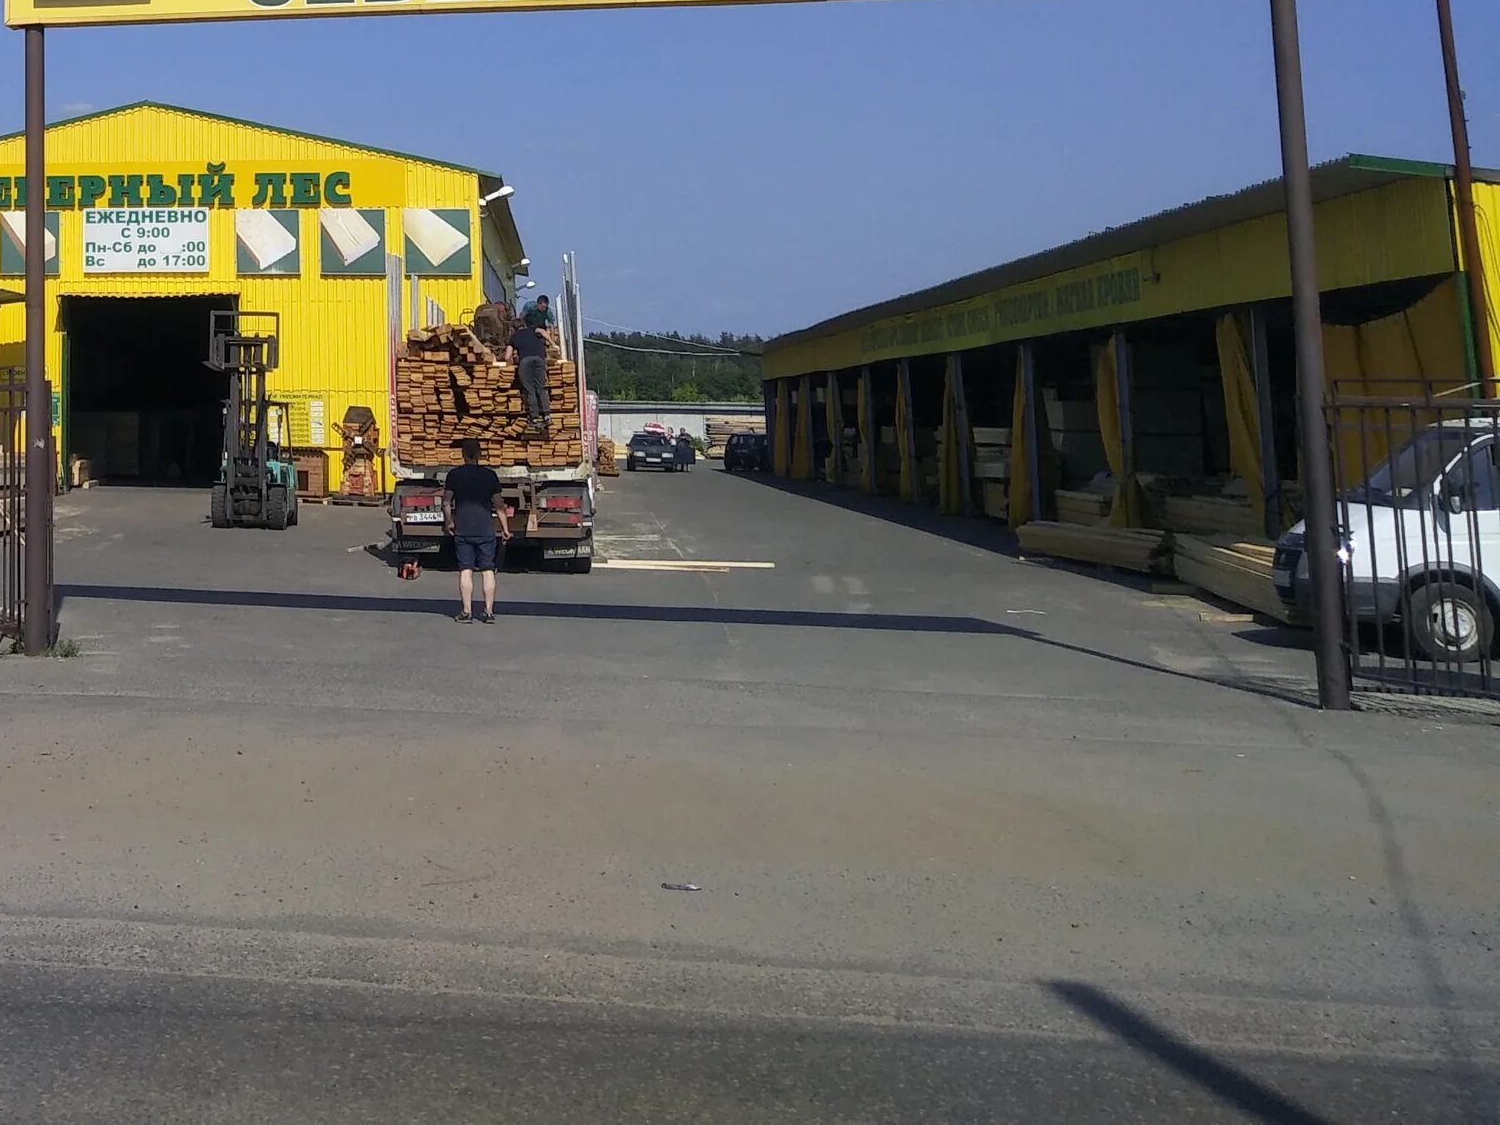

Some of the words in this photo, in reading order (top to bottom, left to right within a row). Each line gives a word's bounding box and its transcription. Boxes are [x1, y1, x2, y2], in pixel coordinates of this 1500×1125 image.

[252, 172, 353, 207] ЛЕС
[85, 210, 207, 225] ЕЖЕДНЕВНО
[121, 227, 131, 238] С
[137, 227, 170, 238] 9:00
[85, 241, 132, 253] Пн-Сб
[137, 244, 156, 254] до
[85, 255, 105, 266] Вс
[137, 257, 156, 268] до
[162, 255, 205, 266] 17:00
